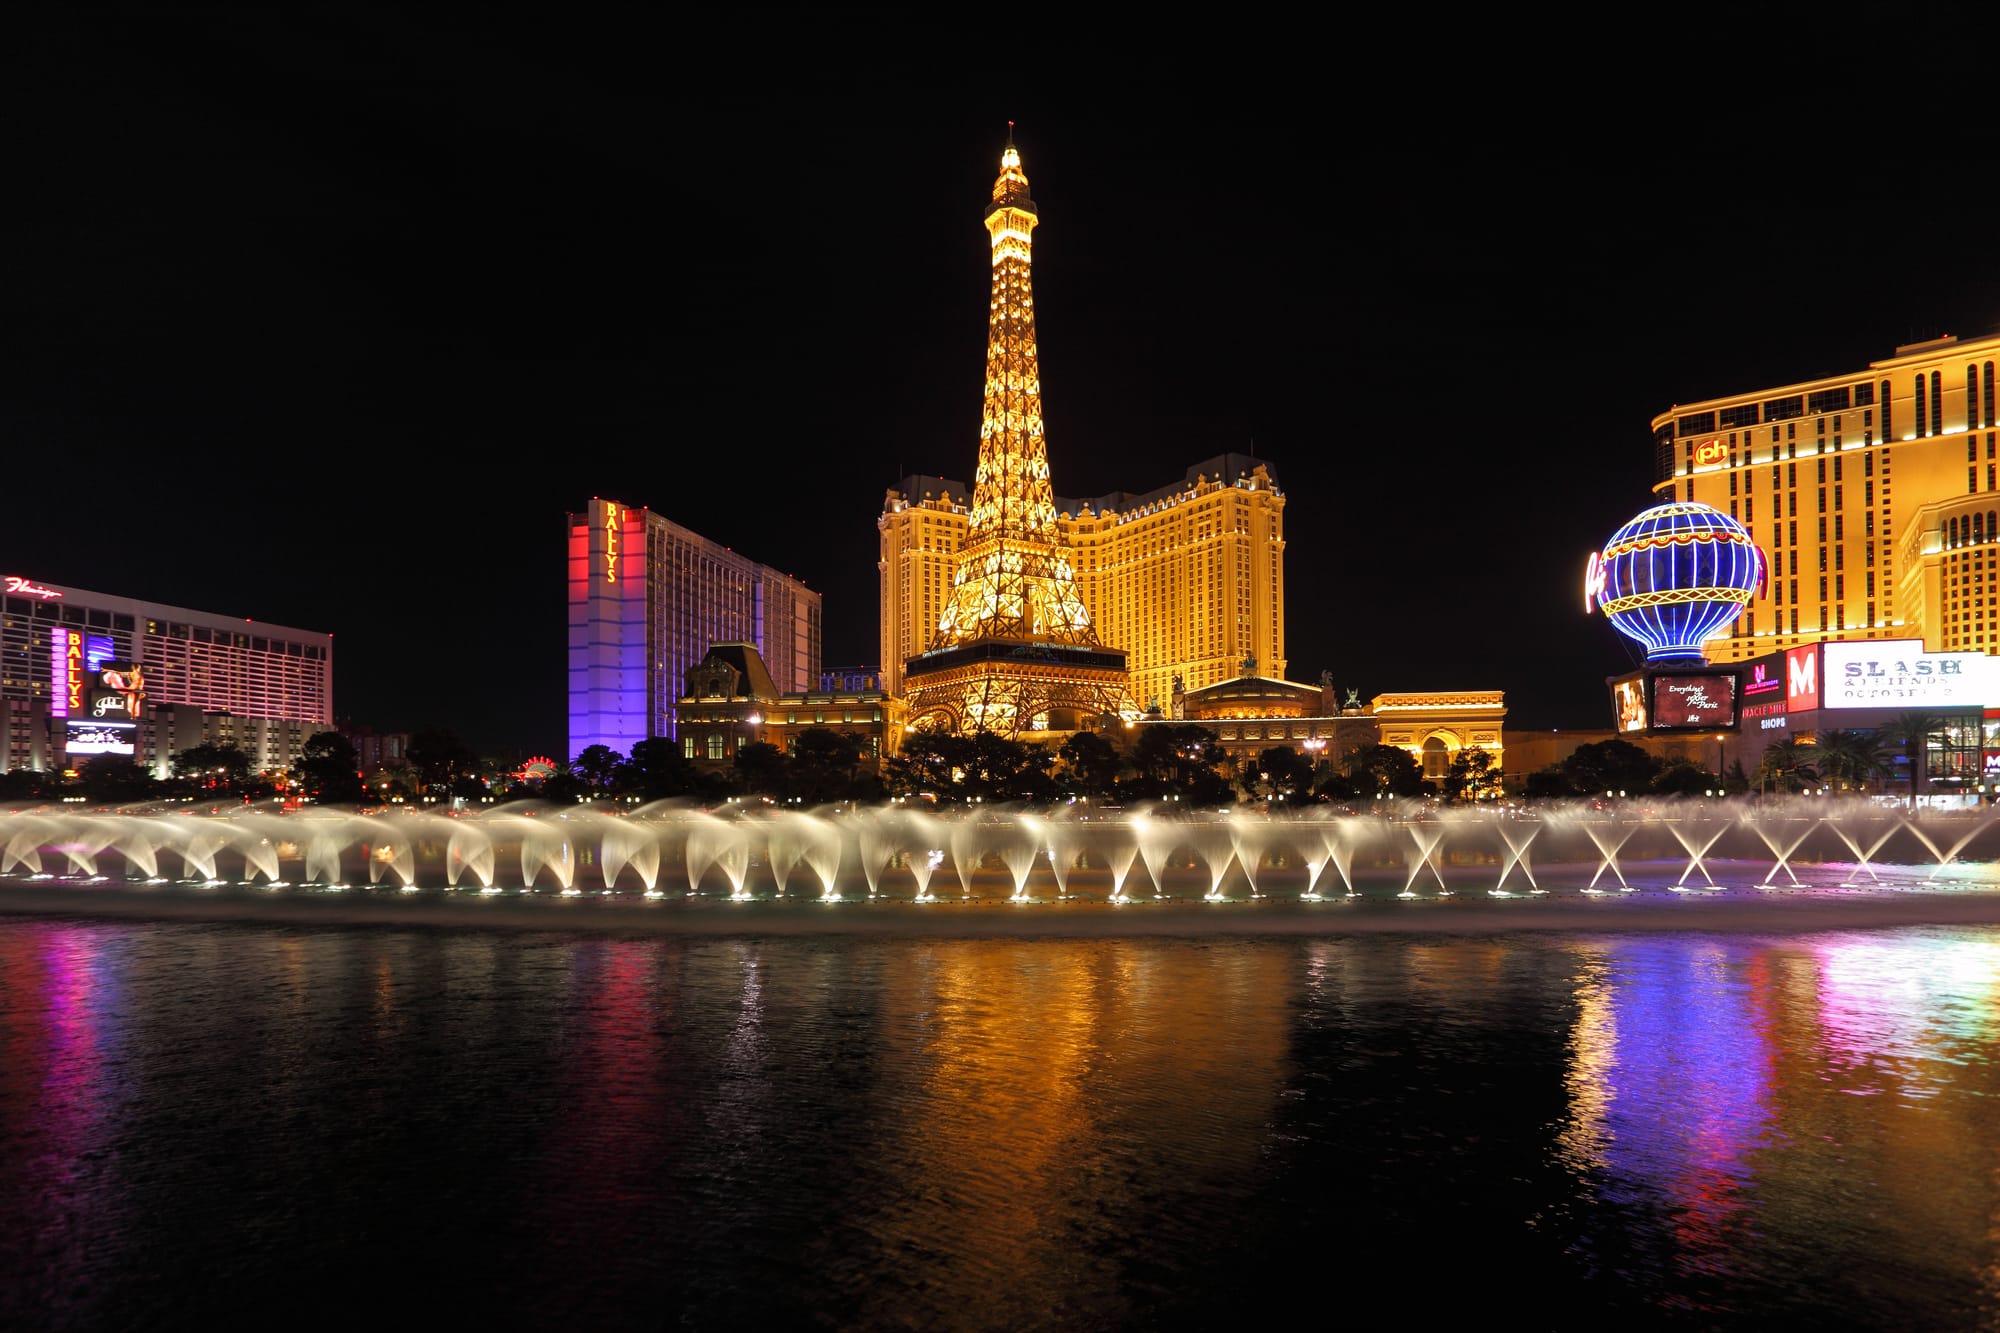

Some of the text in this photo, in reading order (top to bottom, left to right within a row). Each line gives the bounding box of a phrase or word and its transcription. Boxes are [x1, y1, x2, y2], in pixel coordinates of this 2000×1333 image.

[1699, 440, 1728, 464] ph
[605, 502, 618, 583] BALLYS
[67, 632, 82, 708] BALLYS
[1789, 652, 1816, 698] M
[1845, 660, 1962, 677] SLASH
[1845, 678, 1855, 686] &
[1761, 717, 1786, 729] SHOPS
